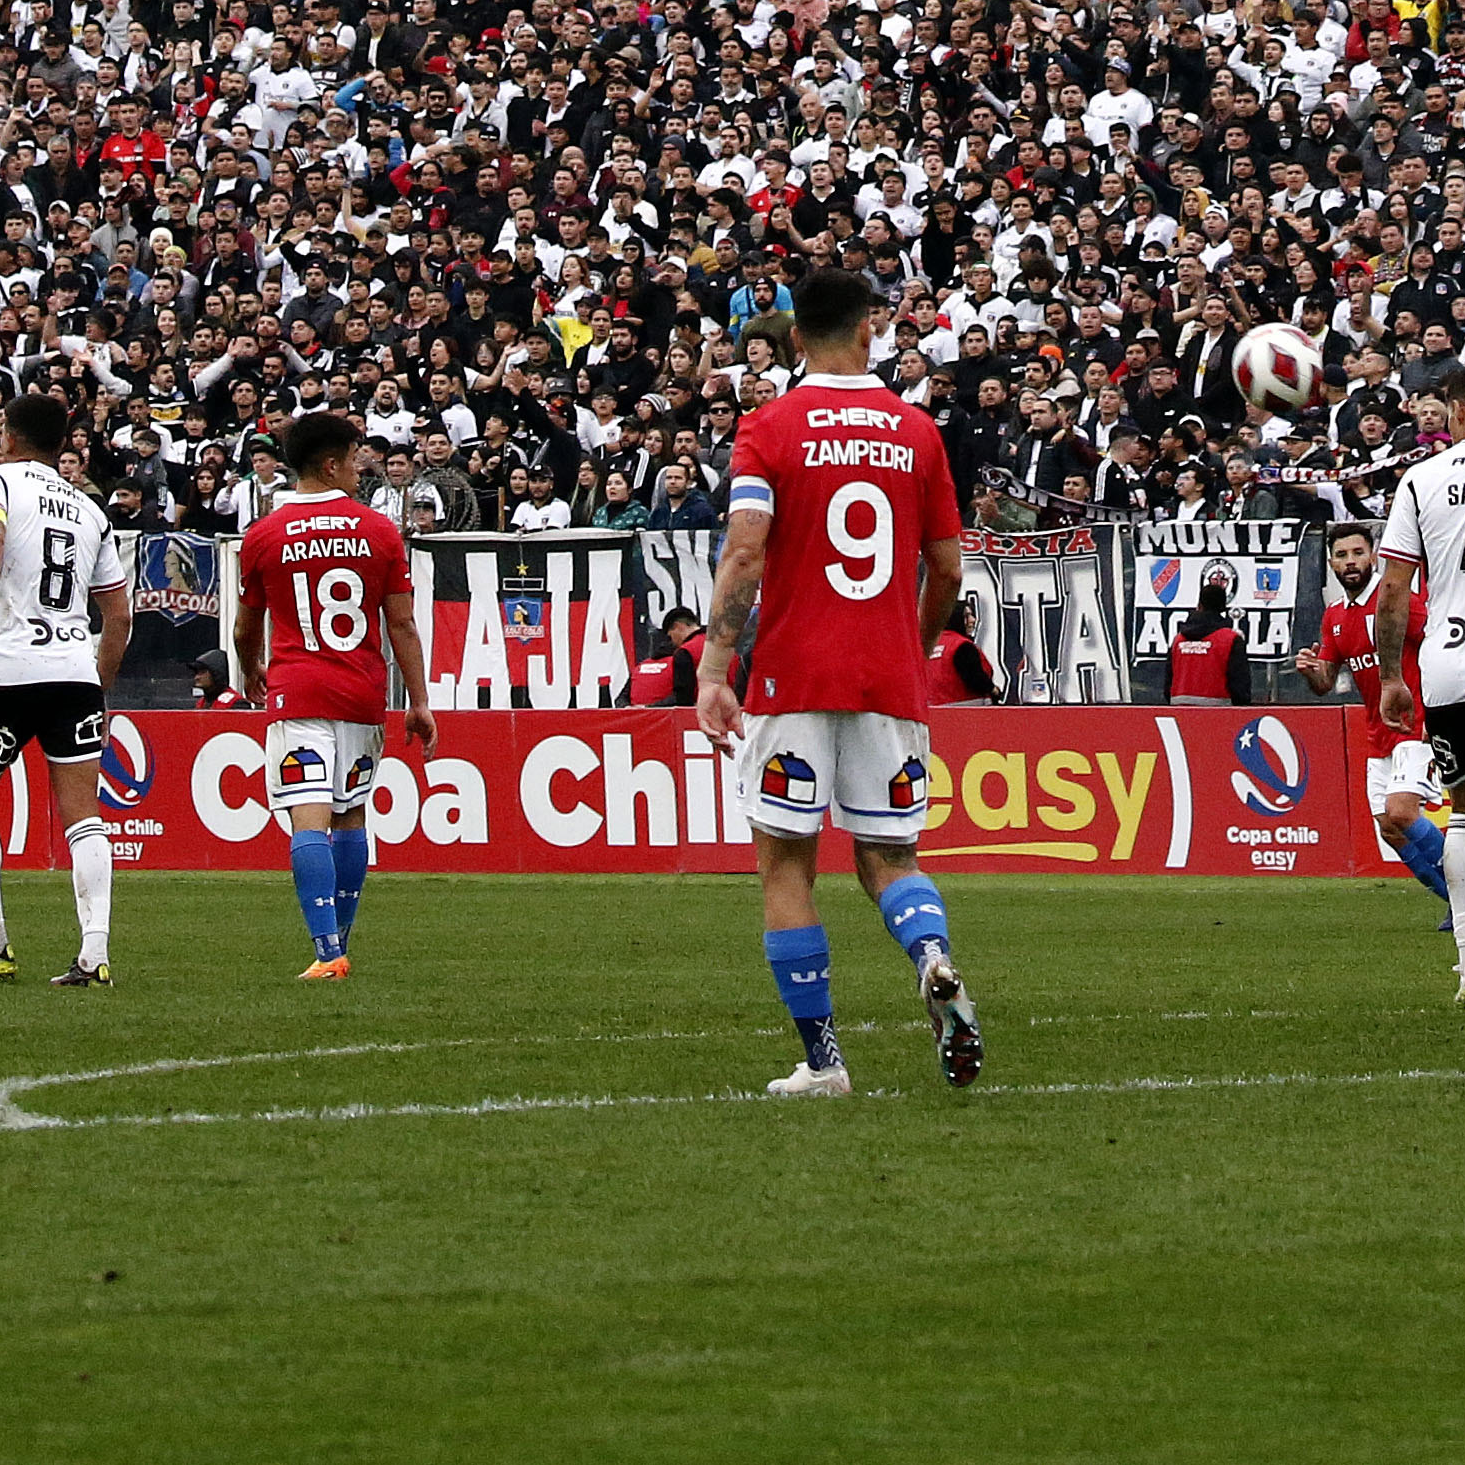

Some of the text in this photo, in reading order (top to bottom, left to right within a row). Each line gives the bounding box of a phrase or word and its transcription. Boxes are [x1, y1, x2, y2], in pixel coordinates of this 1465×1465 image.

[806, 408, 902, 432] CHERY
[801, 440, 914, 473] ZAMPEDRI
[38, 494, 83, 526] PAVEZ
[285, 516, 361, 536] CHERY
[824, 481, 895, 601] 9
[281, 538, 372, 564] ARAVENA
[959, 528, 1097, 557] SEXTA
[39, 527, 77, 613] 8
[292, 567, 368, 653] 18
[407, 547, 631, 710] LAJA
[191, 731, 753, 866] Cpa Chil
[123, 819, 164, 836] Chile
[1226, 826, 1320, 847] Copa Chile
[1250, 849, 1298, 872] easy
